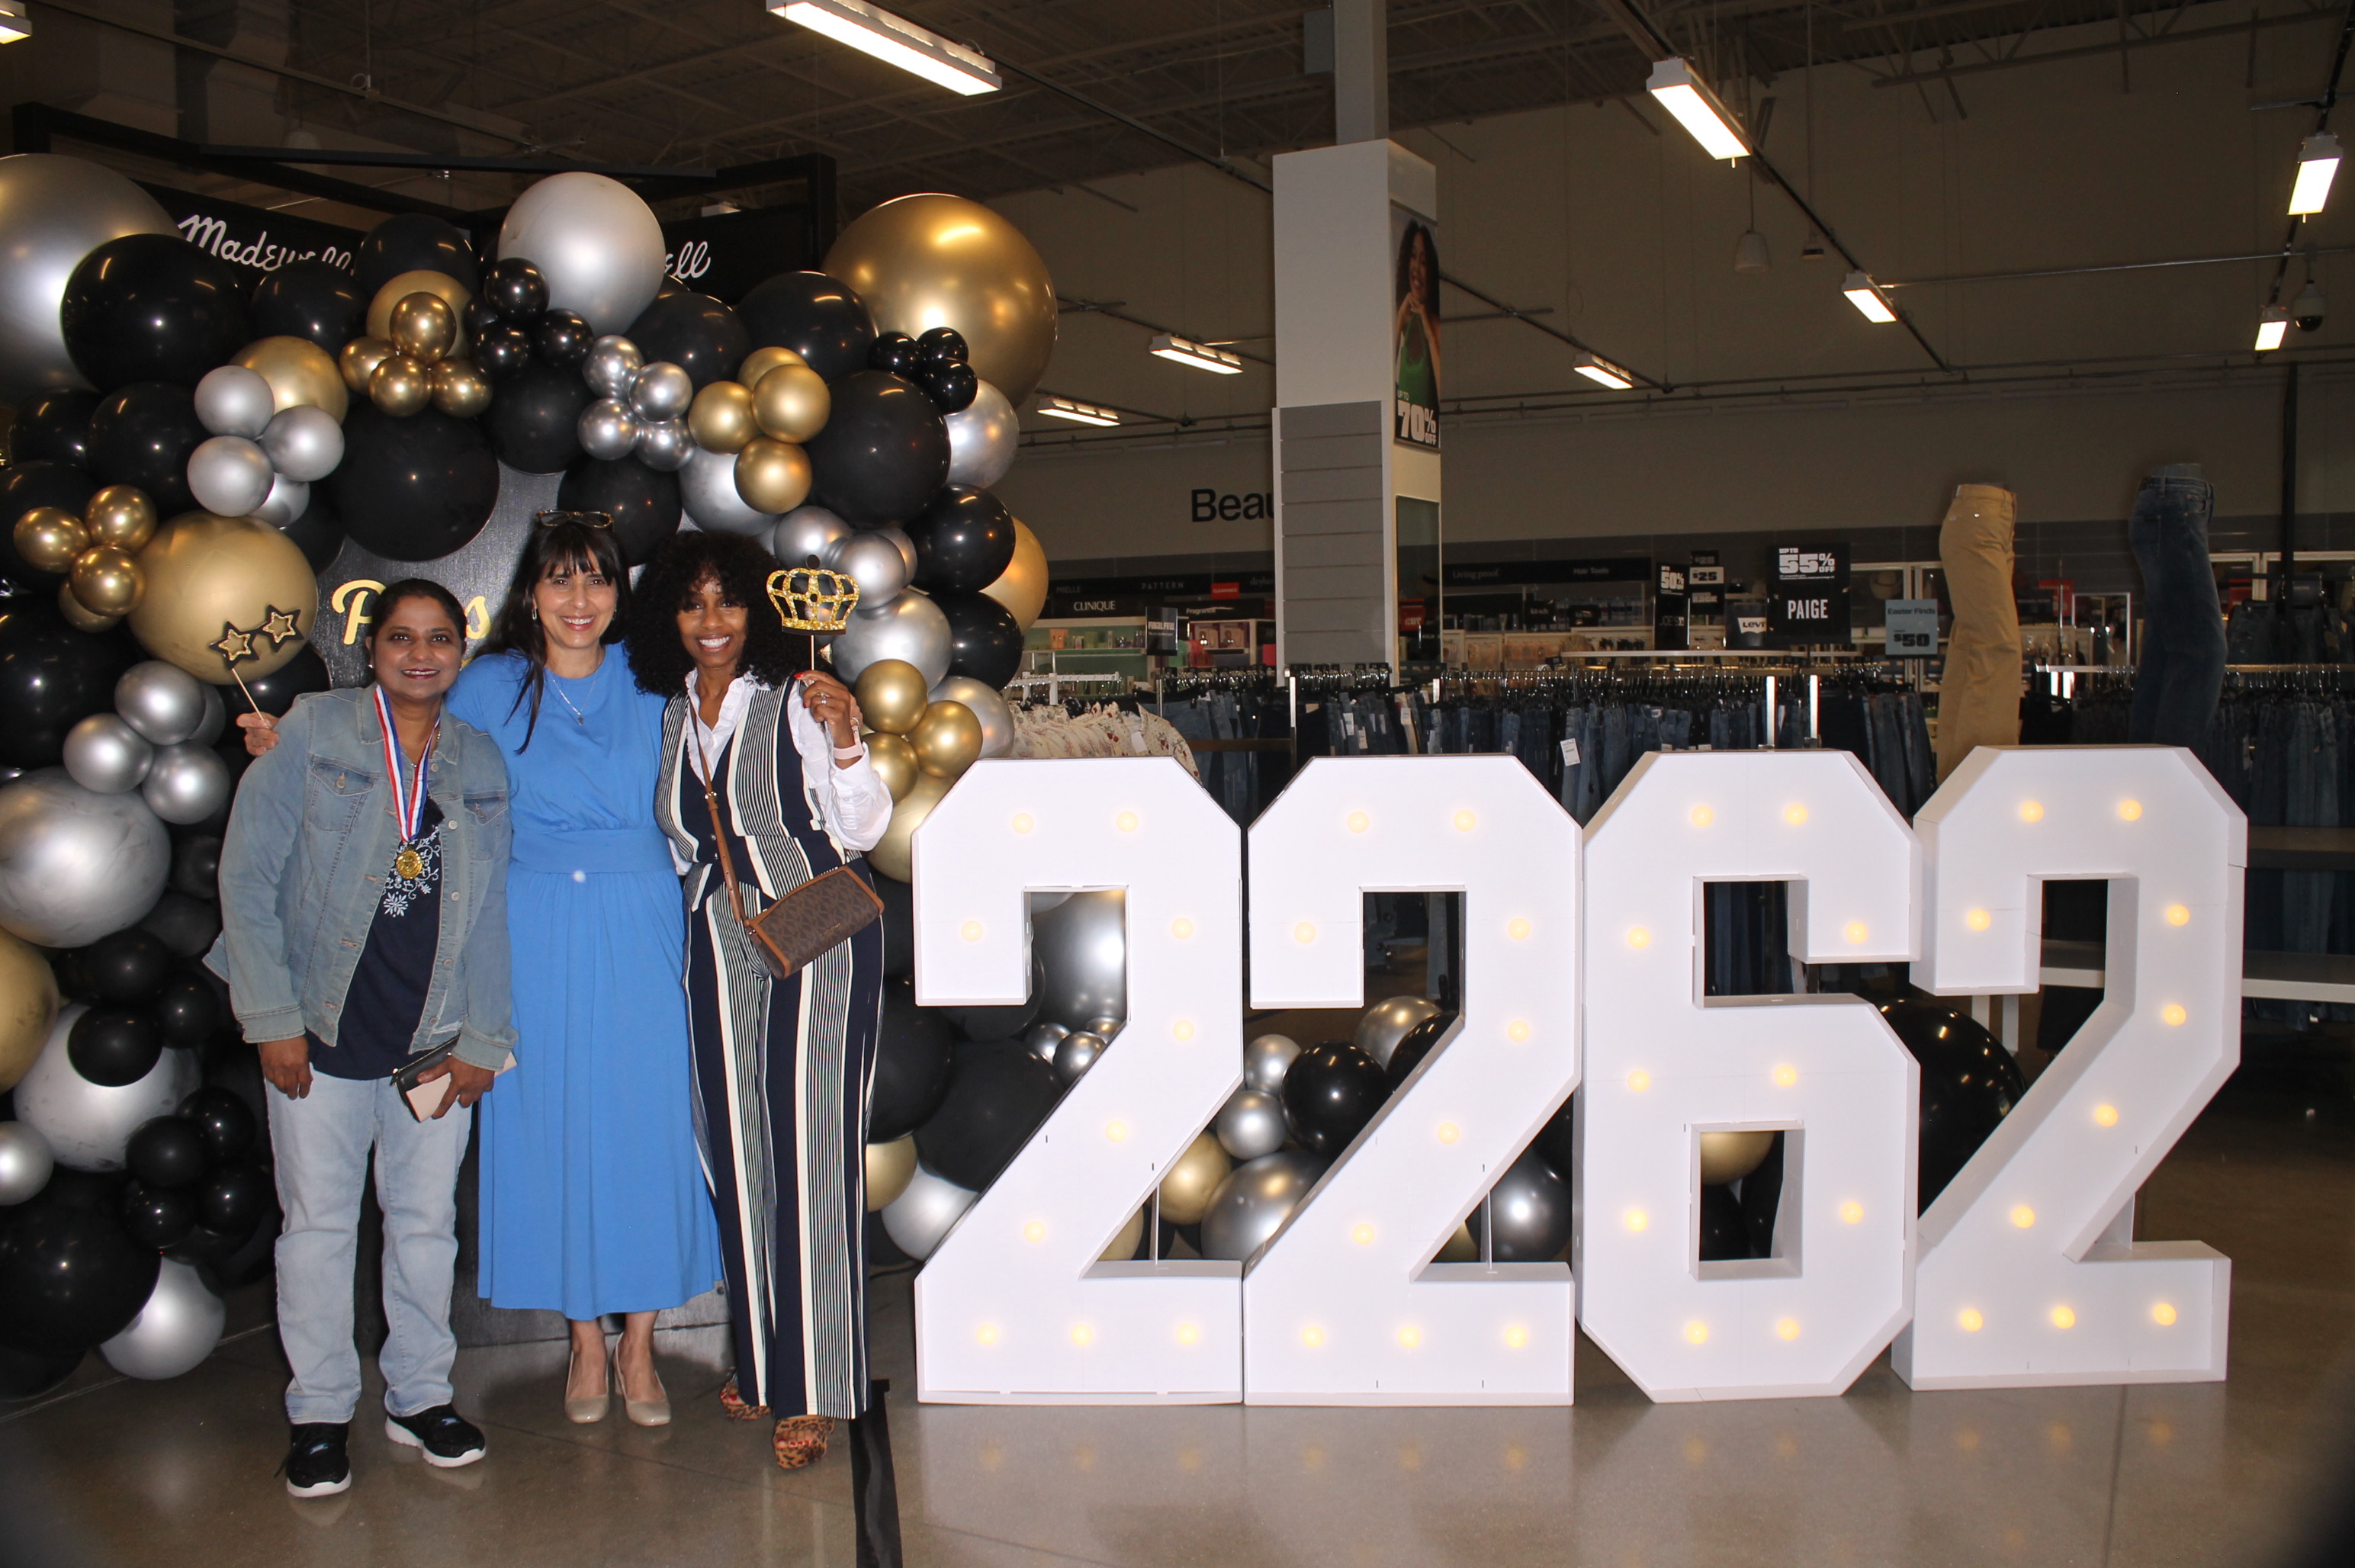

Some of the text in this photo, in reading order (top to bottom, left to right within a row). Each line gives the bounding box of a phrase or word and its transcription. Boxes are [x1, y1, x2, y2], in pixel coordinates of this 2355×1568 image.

[1397, 399, 1437, 442] 70%
[1425, 432, 1437, 445] OFF
[1778, 552, 1836, 574] 55%
[1692, 571, 1717, 582] $25
[1056, 585, 1081, 593] MIELLE
[1141, 581, 1184, 590] PATTERN
[1073, 599, 1116, 612] CLINIQUE
[1787, 599, 1829, 620] PAIGE
[1894, 634, 1930, 647] $50
[914, 746, 2248, 1408] 2262
